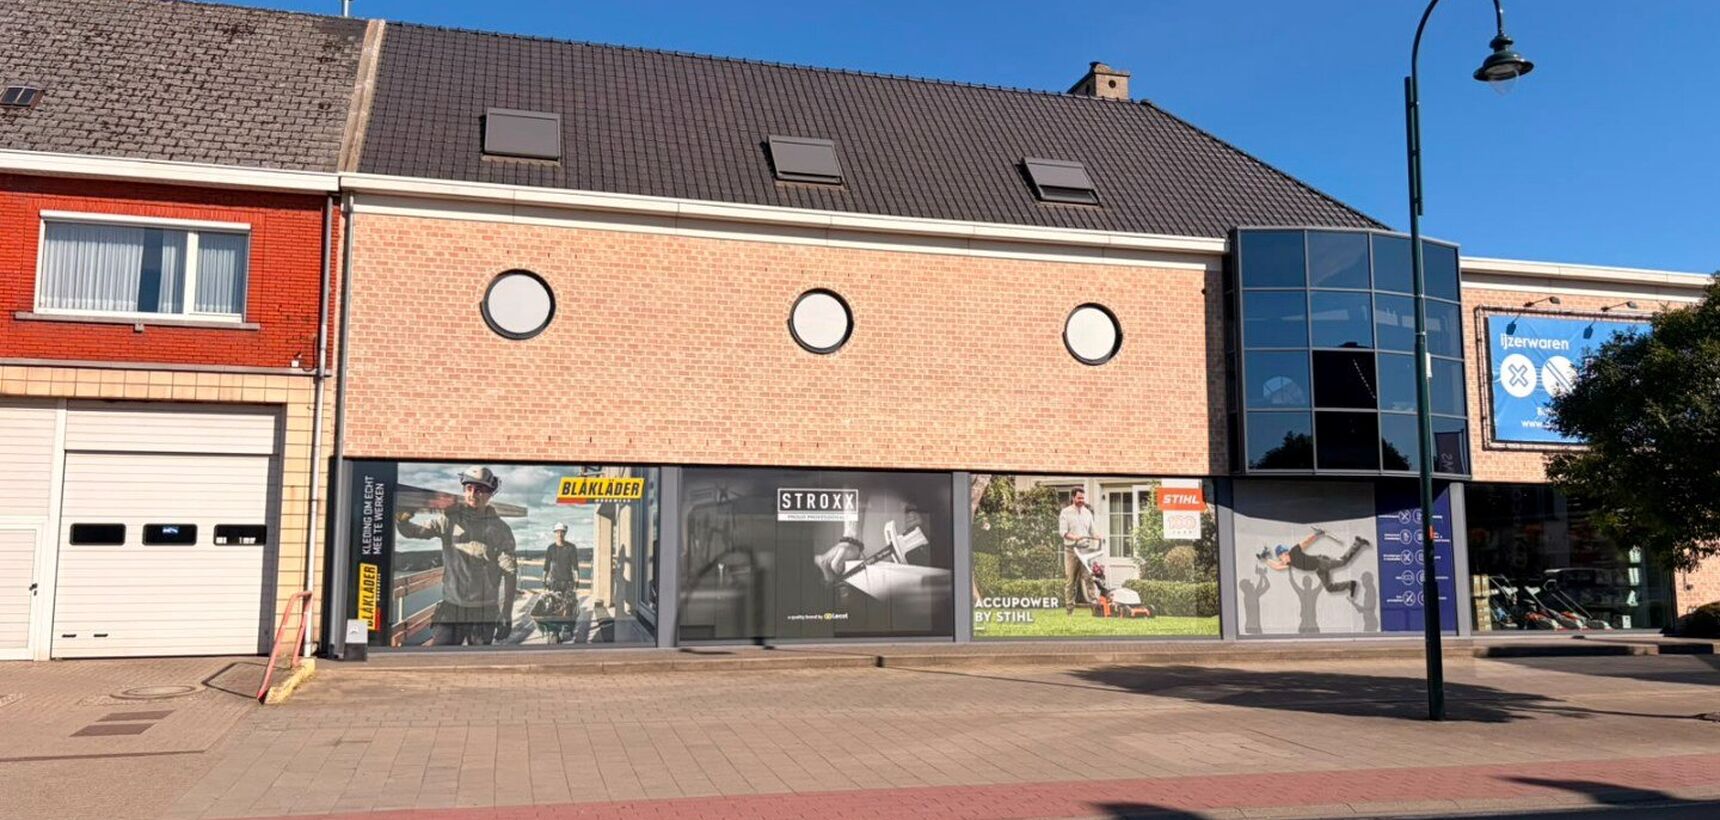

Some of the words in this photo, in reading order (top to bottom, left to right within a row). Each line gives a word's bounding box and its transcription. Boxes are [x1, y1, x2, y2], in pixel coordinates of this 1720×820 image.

[364, 475, 375, 499] ECHT
[561, 478, 640, 496] BLÅKLÄDER
[374, 482, 385, 521] WERKEN
[782, 493, 854, 509] STROXX
[1163, 494, 1200, 505] STIHL
[363, 500, 374, 516] OM
[362, 516, 373, 555] KLEDING
[373, 522, 384, 535] TE
[372, 535, 382, 555] MEE
[974, 597, 1059, 608] ACCUPOWER
[975, 611, 992, 622] BY
[996, 611, 1033, 622] STIHL
